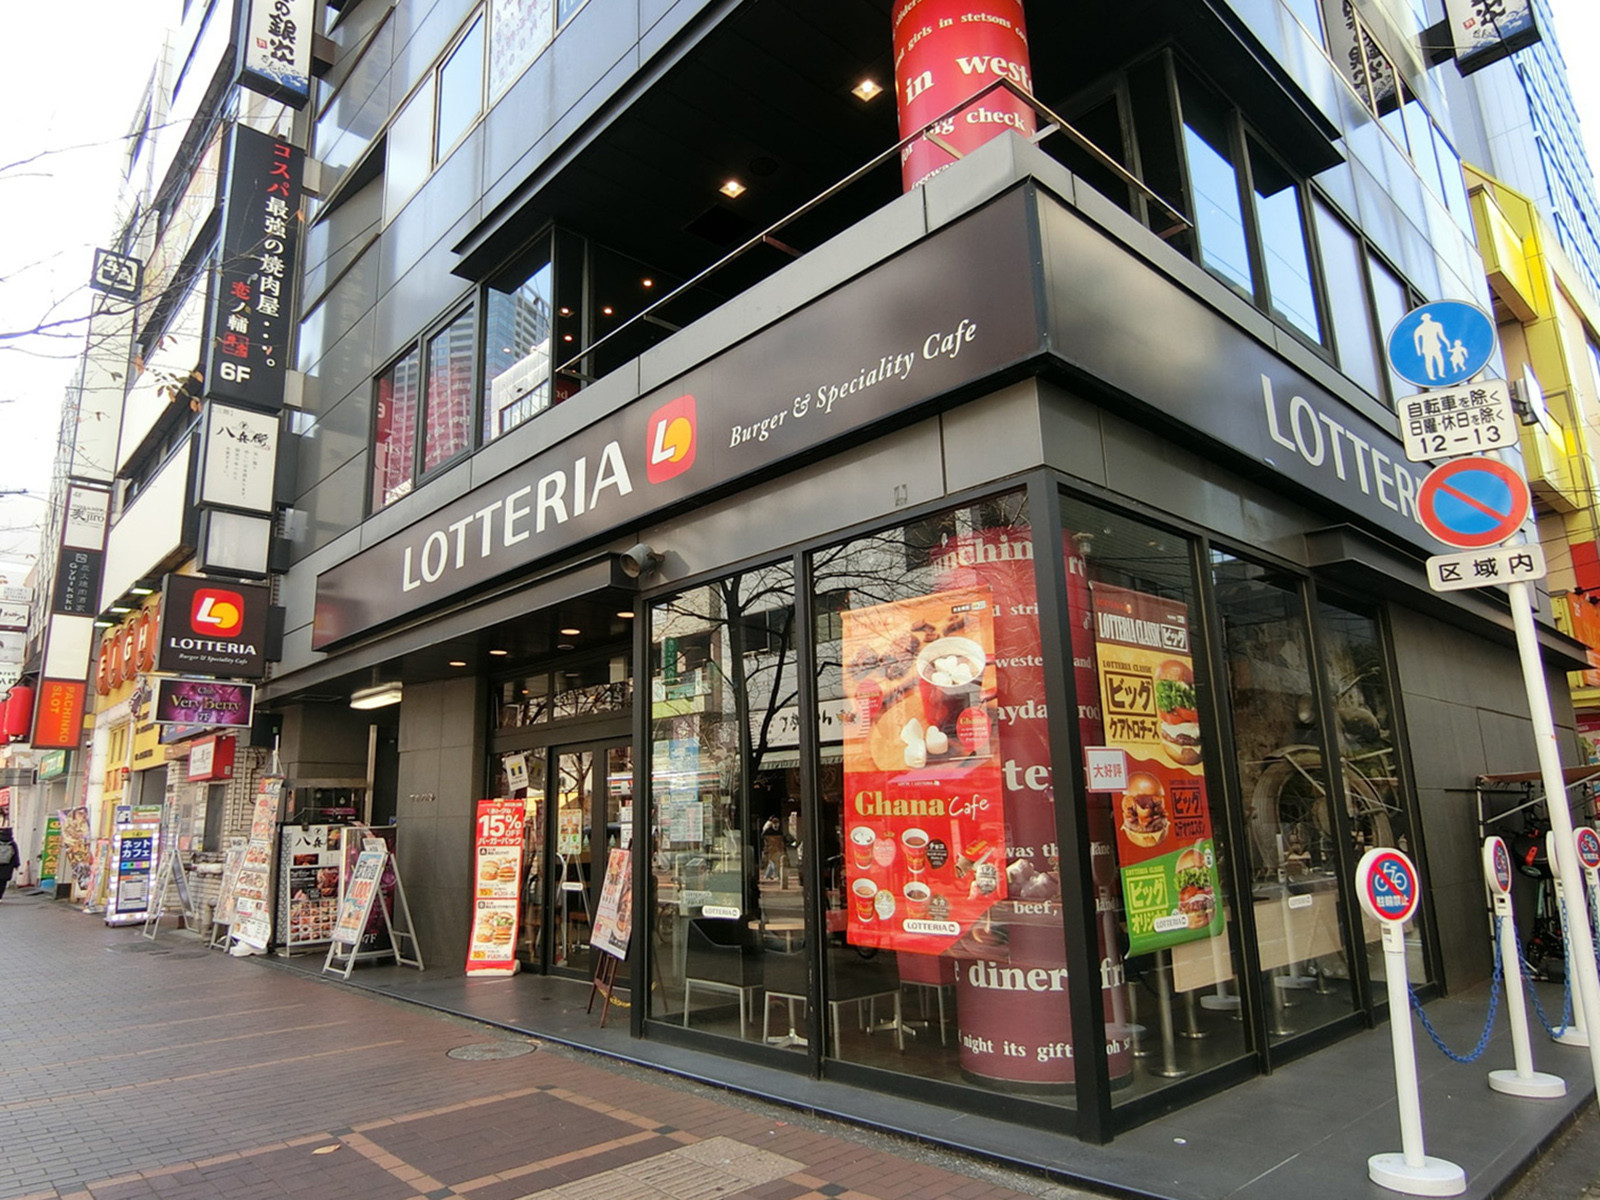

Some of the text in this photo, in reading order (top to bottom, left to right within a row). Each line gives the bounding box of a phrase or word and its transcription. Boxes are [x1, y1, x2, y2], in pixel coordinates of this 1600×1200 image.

[268, 0, 297, 66] の銀次
[908, 26, 932, 51] girls
[939, 18, 953, 28] in
[961, 13, 1011, 28] stetsons
[906, 56, 1034, 105] in west
[966, 108, 1026, 132] check
[220, 361, 251, 383] 6F
[729, 318, 977, 448] Burger & Speciality Cafe
[1407, 388, 1500, 418] 自転車を除く
[1410, 407, 1505, 437] 日曜・休日を除く
[1260, 373, 1422, 526] LOTTER
[402, 440, 633, 592] LOTTERIA
[1438, 553, 1534, 583] 区域内
[1098, 612, 1162, 647] LOTTERIA CLASSIC
[1162, 626, 1186, 650] ビッグ
[170, 637, 257, 656] LOTTERIA
[179, 653, 199, 662] Burger
[207, 655, 234, 665] Speciality
[50, 684, 62, 714] SLOT
[171, 694, 202, 711] Very
[1108, 676, 1152, 711] ビッグ
[59, 685, 75, 743] PACHINKO
[1109, 717, 1160, 740] クアトロチーズ
[1002, 759, 1053, 791] te
[1093, 764, 1123, 779] 大好評
[854, 790, 990, 821] Ghana Cafe
[1172, 792, 1200, 815] ビッグ
[478, 814, 522, 838] 15%
[122, 839, 151, 849] ネット
[122, 849, 151, 858] カフェ
[1014, 901, 1058, 917] beef,
[1129, 880, 1167, 909] ビッグ
[907, 921, 948, 932] LOTTERIA
[968, 959, 1068, 992] diner
[964, 1033, 1074, 1063] night its gift
[1106, 1038, 1120, 1056] oh
